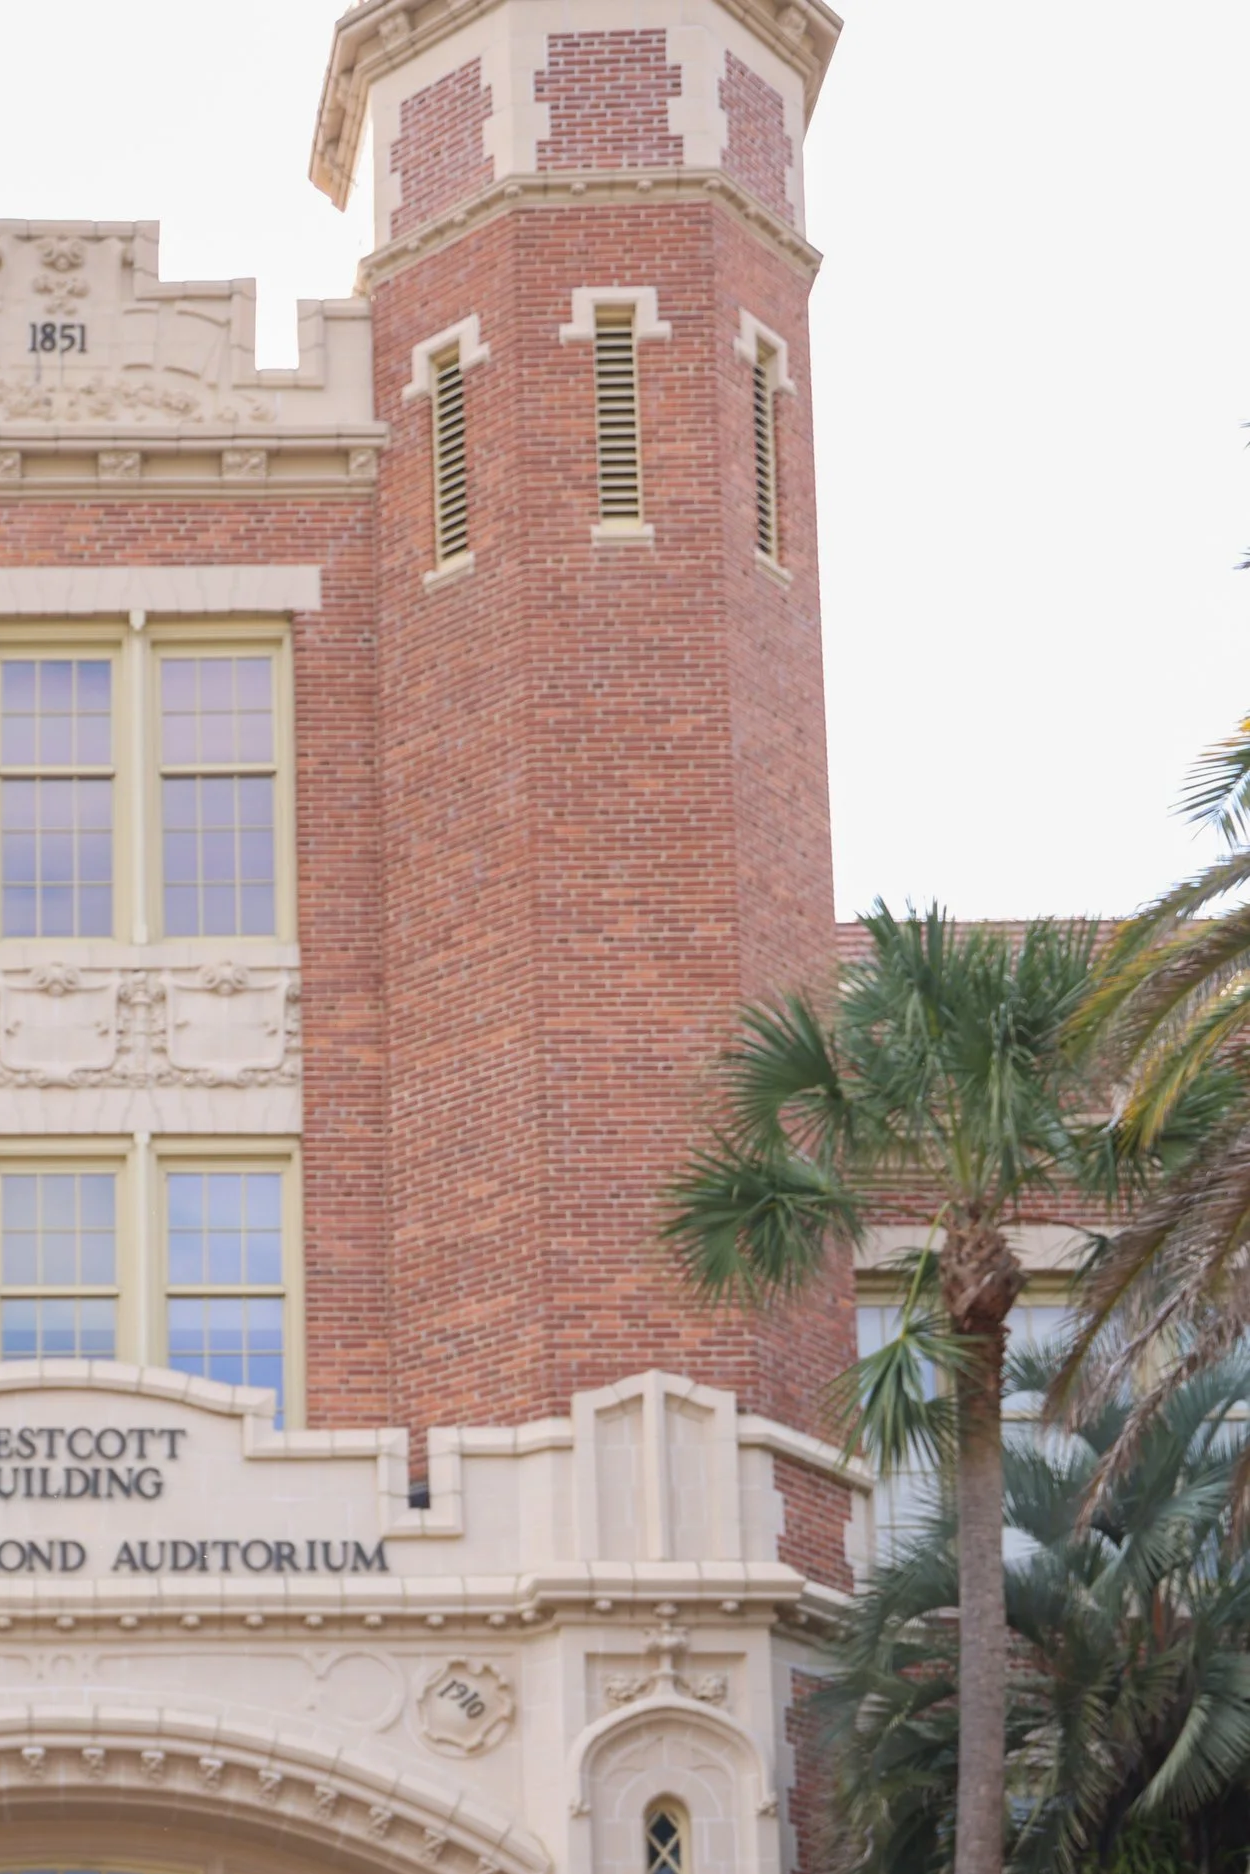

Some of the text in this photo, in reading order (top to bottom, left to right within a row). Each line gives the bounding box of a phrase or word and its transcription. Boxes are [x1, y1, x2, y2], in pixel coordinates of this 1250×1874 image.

[28, 322, 88, 353] 1851
[111, 1539, 388, 1573] AUDITORIUM
[437, 1679, 486, 1720] 1910
